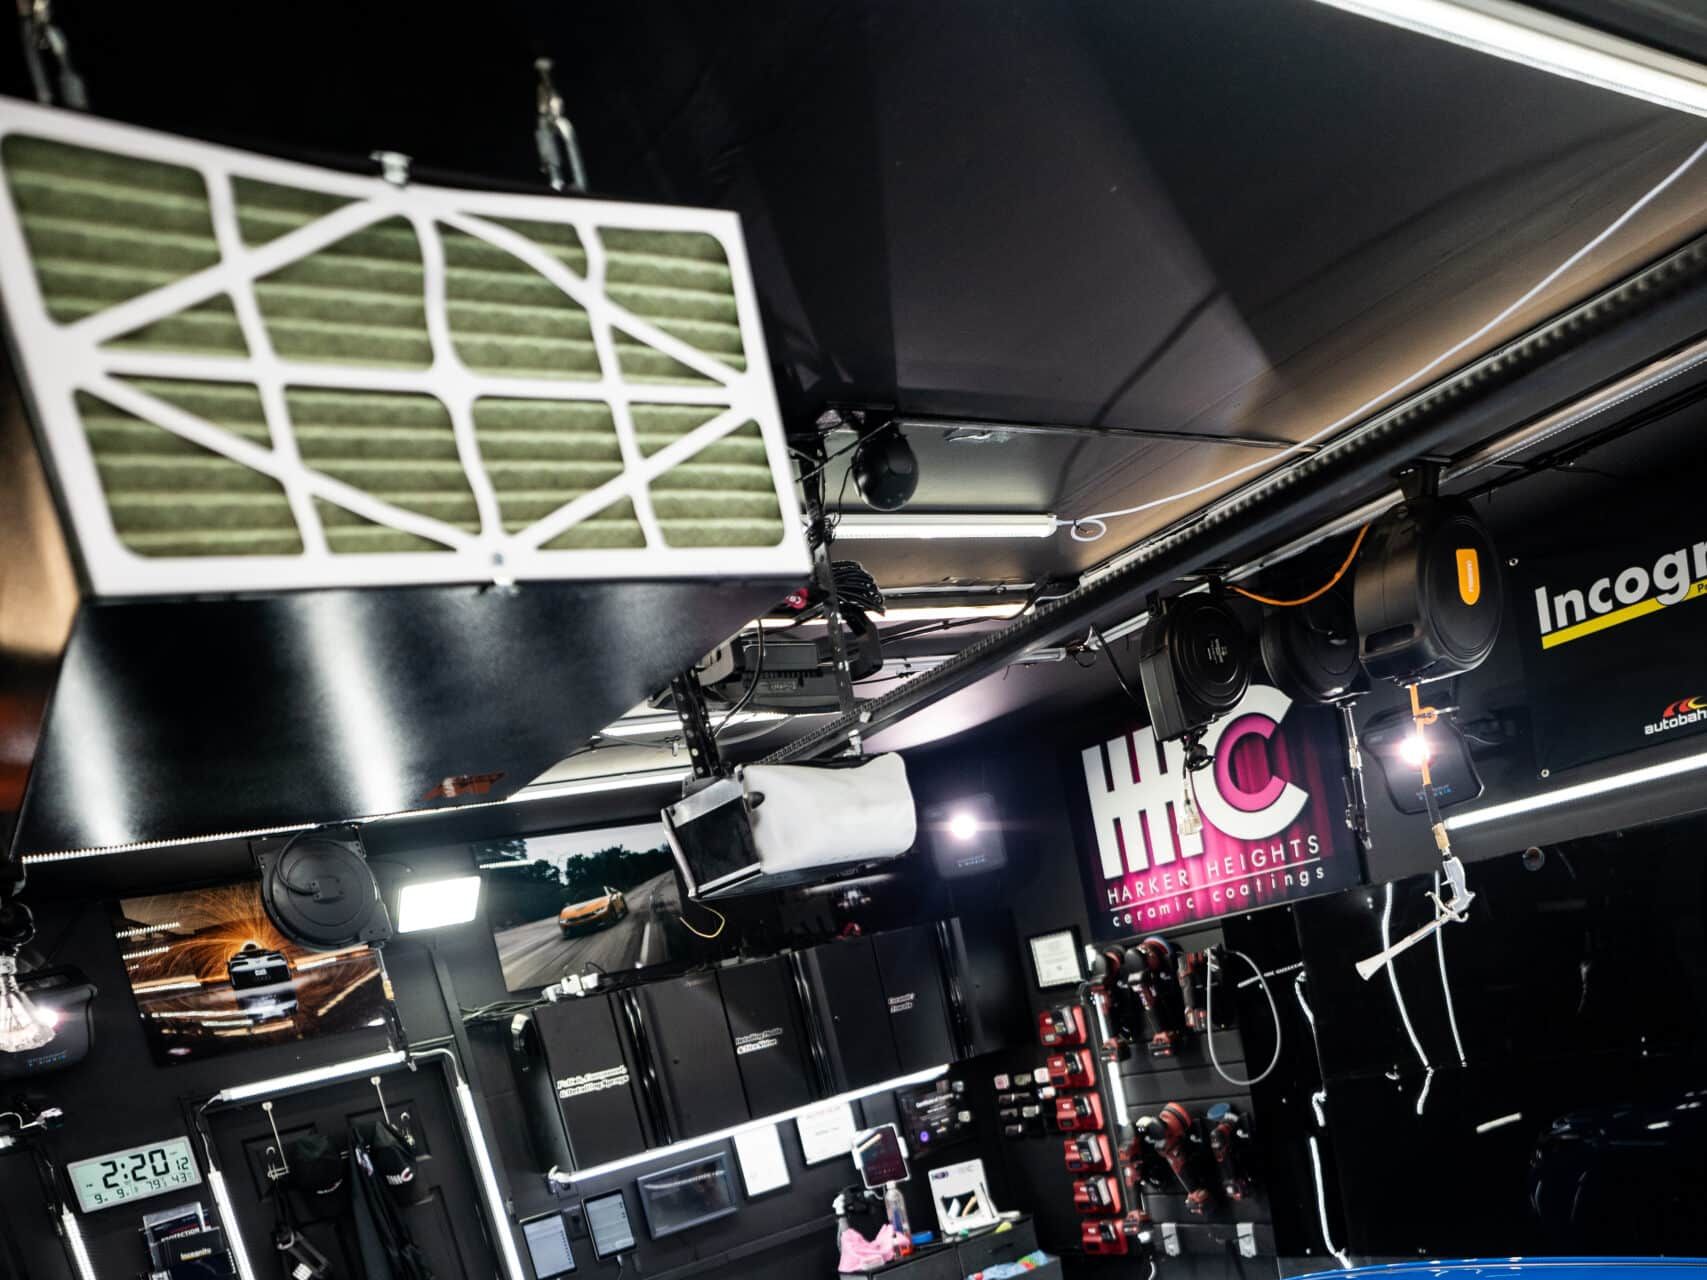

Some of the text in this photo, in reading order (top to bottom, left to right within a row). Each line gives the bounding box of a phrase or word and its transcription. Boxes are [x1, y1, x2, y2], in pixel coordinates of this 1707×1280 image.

[1081, 684, 1309, 879] HHC
[1107, 834, 1320, 905] HARKER HEIGHTS
[1112, 866, 1325, 927] ceramic coatings
[100, 1148, 190, 1189] 2:20 12
